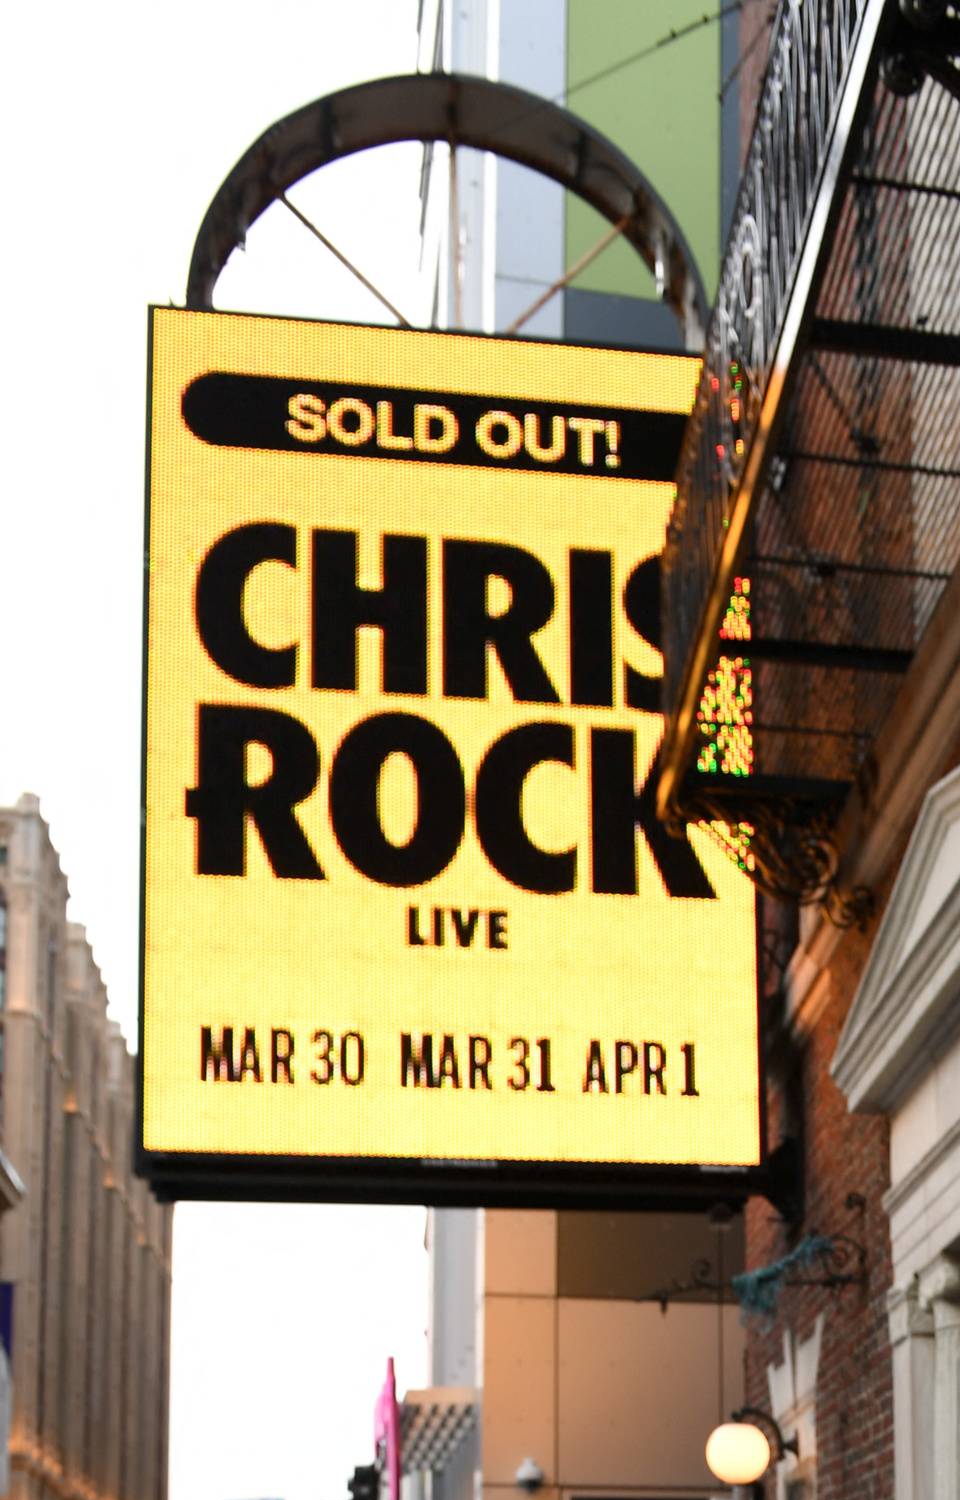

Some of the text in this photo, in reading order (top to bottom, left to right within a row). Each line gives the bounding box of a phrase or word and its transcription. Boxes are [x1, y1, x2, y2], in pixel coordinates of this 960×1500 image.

[286, 393, 621, 468] SOLD OUT!
[185, 702, 721, 900] ROCK
[406, 906, 508, 949] LIVE
[200, 1025, 700, 1098] MAR 30 MAR 31 APR 1
